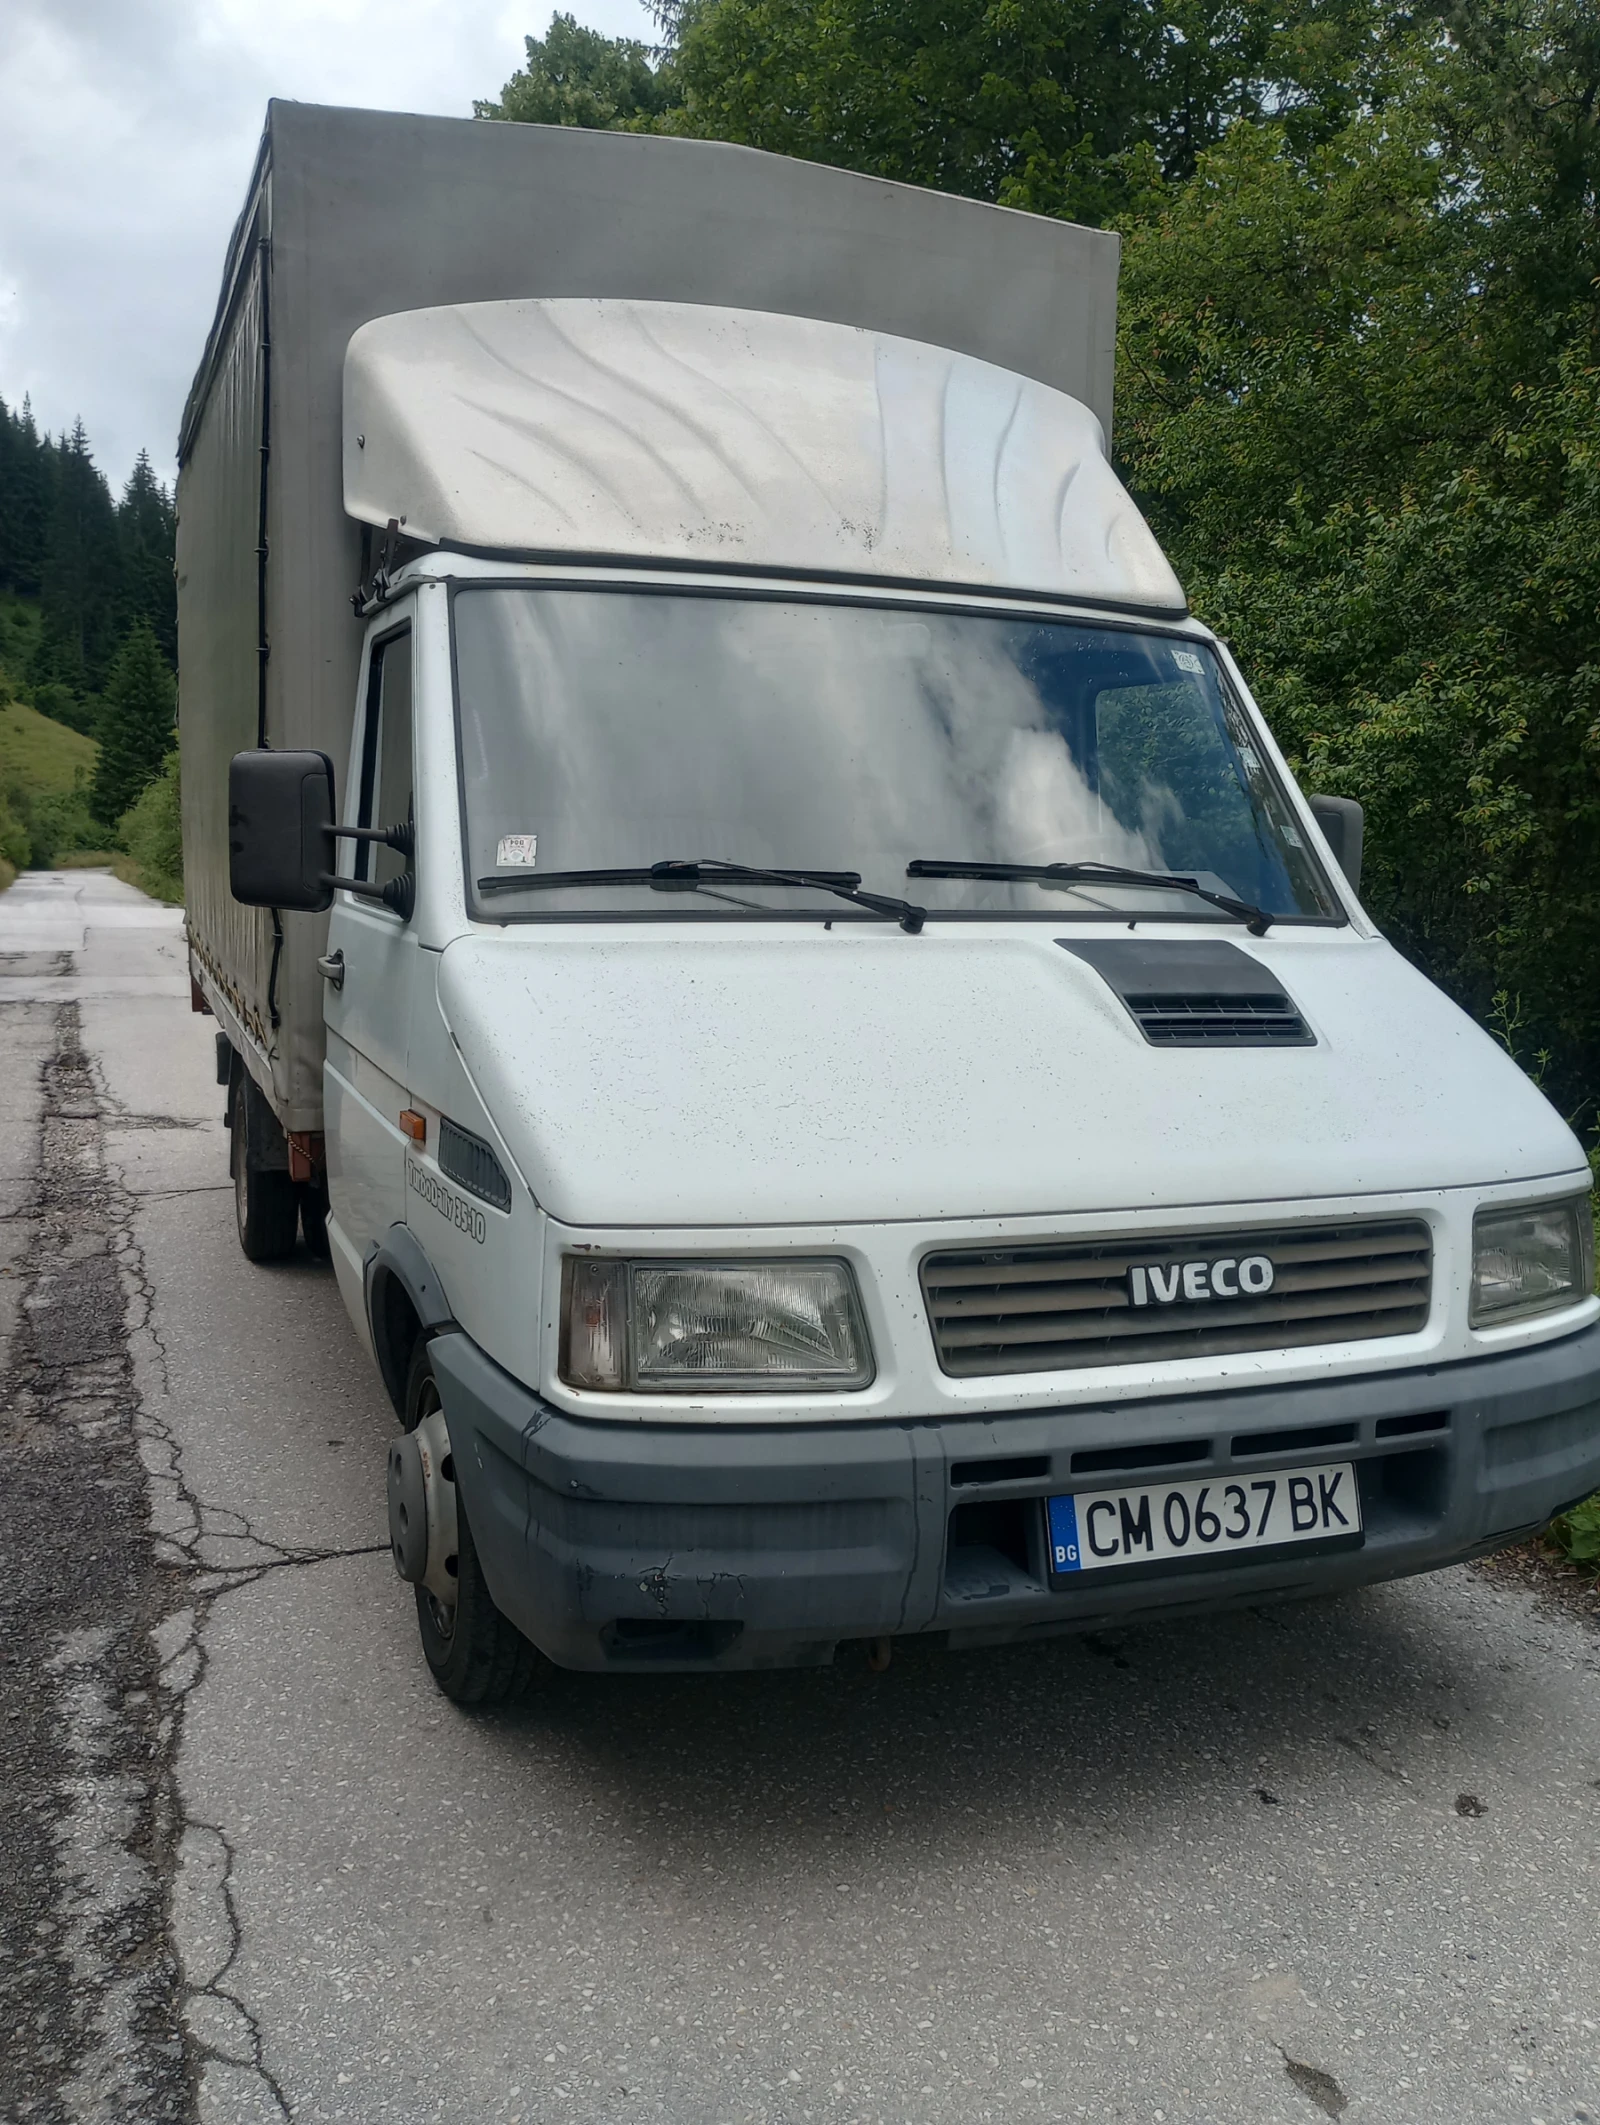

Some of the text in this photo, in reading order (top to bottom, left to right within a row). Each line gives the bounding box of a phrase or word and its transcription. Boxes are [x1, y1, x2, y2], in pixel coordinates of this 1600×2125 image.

[1131, 1256, 1274, 1306] IVECO
[1163, 1480, 1276, 1547] 0637
[1055, 1545, 1077, 1563] BG
